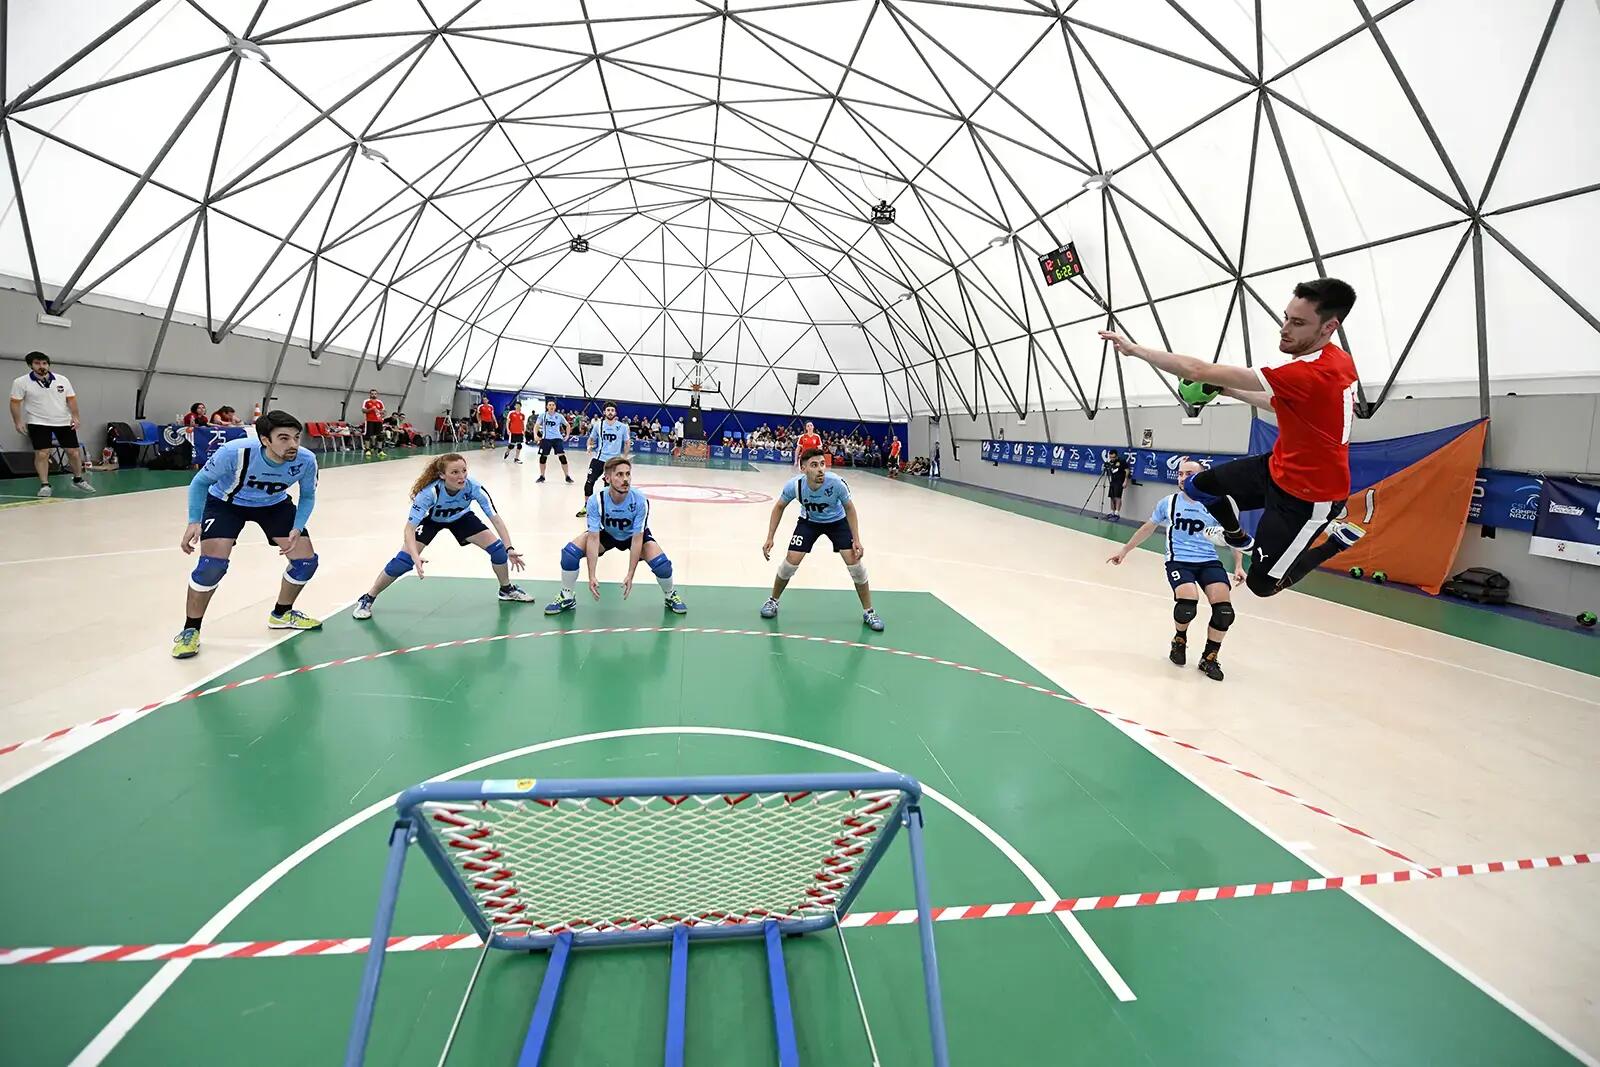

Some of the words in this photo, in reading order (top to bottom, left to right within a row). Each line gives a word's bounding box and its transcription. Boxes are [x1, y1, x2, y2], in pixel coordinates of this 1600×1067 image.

[1066, 251, 1074, 262] 9
[1045, 260, 1054, 271] 12
[1055, 265, 1073, 280] 6:22
[208, 430, 226, 446] 75
[603, 431, 617, 442] imp
[1123, 452, 1137, 465] 75
[246, 475, 289, 495] imp
[204, 519, 215, 532] 7
[606, 513, 632, 531] imp
[1175, 512, 1205, 535] imp
[1171, 570, 1181, 581] 9
